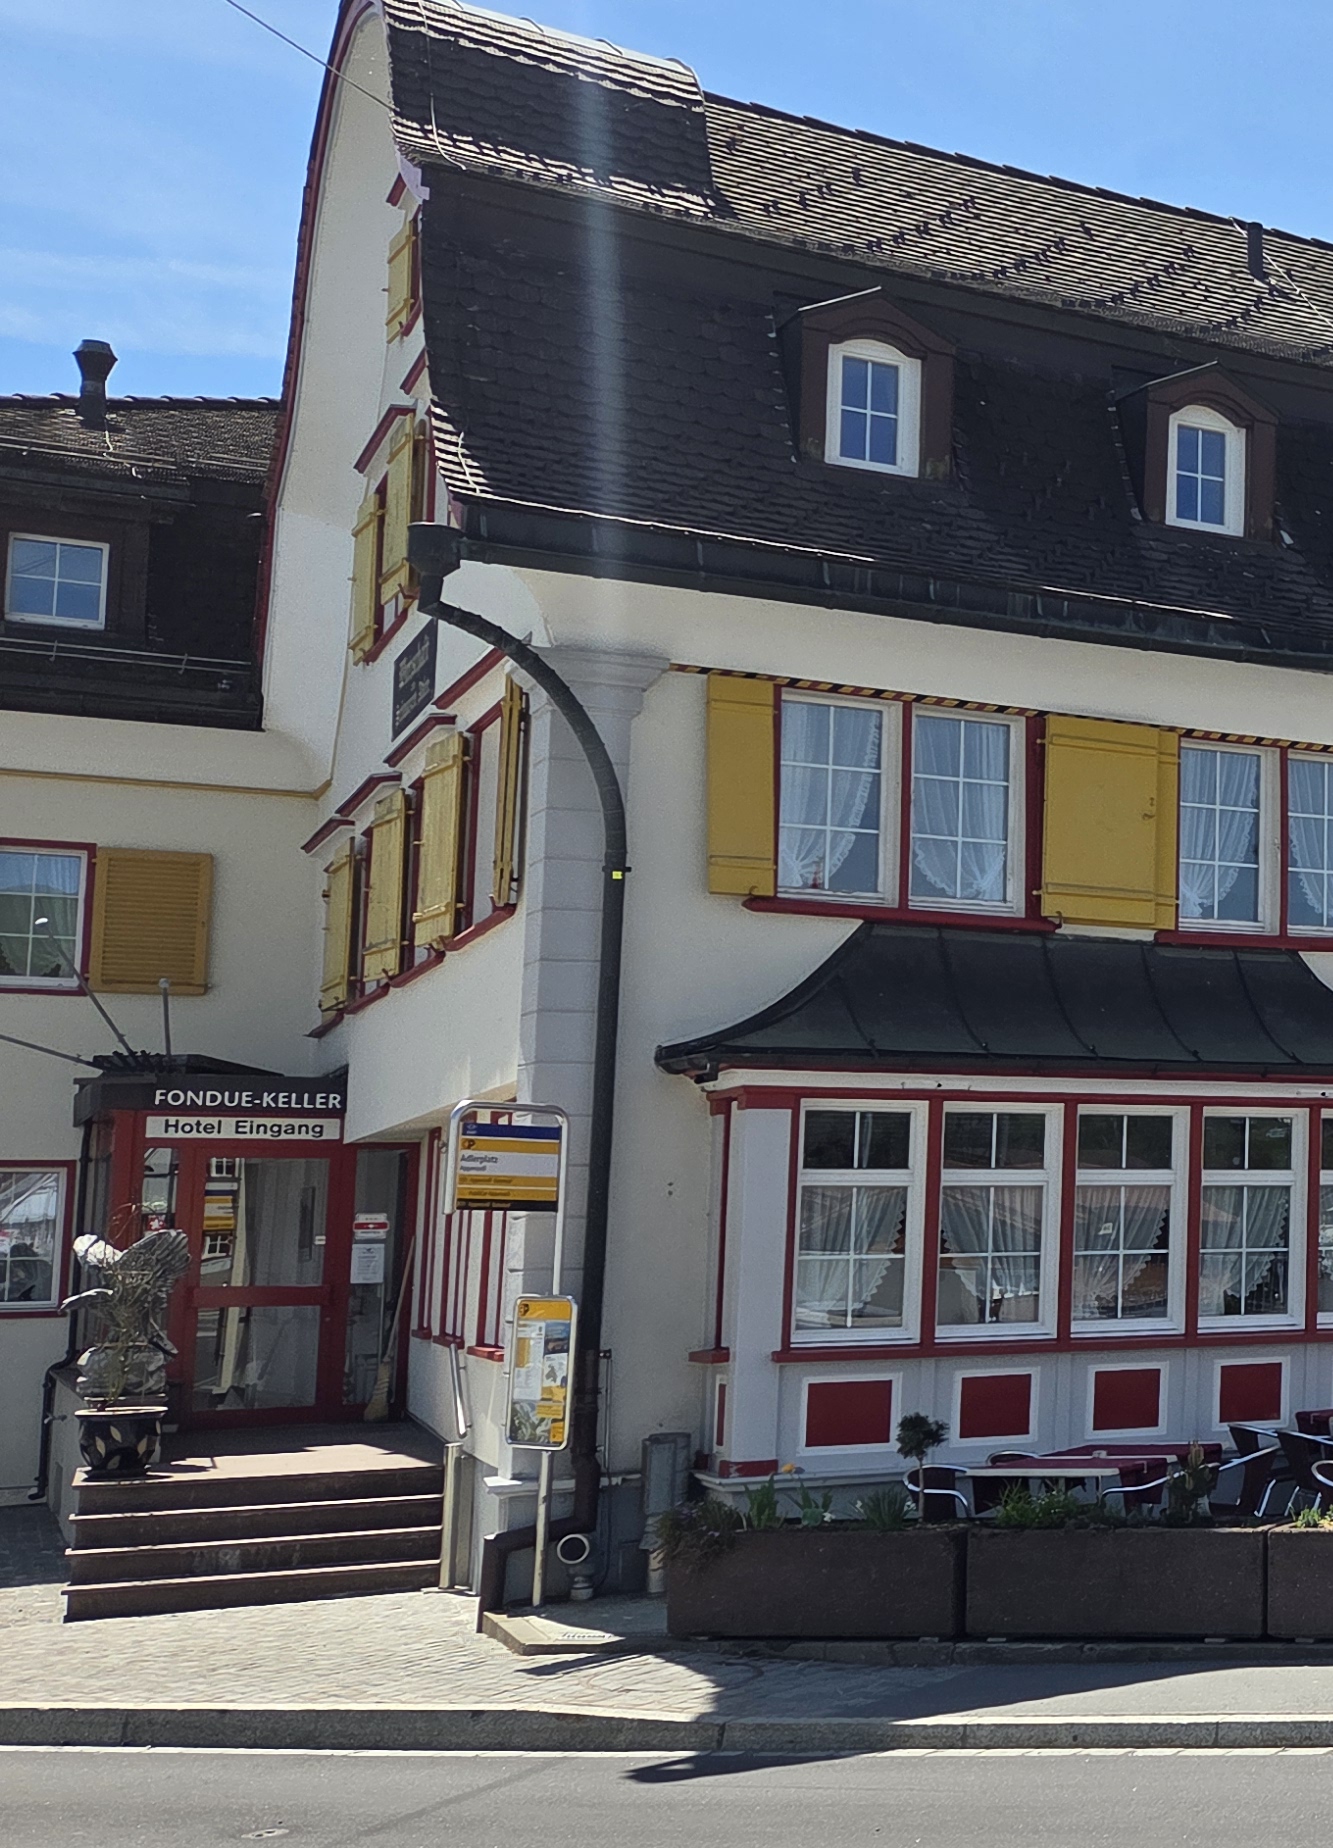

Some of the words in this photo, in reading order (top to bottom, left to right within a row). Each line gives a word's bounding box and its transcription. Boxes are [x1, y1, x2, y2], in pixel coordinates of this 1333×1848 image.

[154, 1089, 342, 1109] FONDUE-KELLER
[163, 1118, 223, 1135] Hotel
[234, 1119, 325, 1139] Eingang
